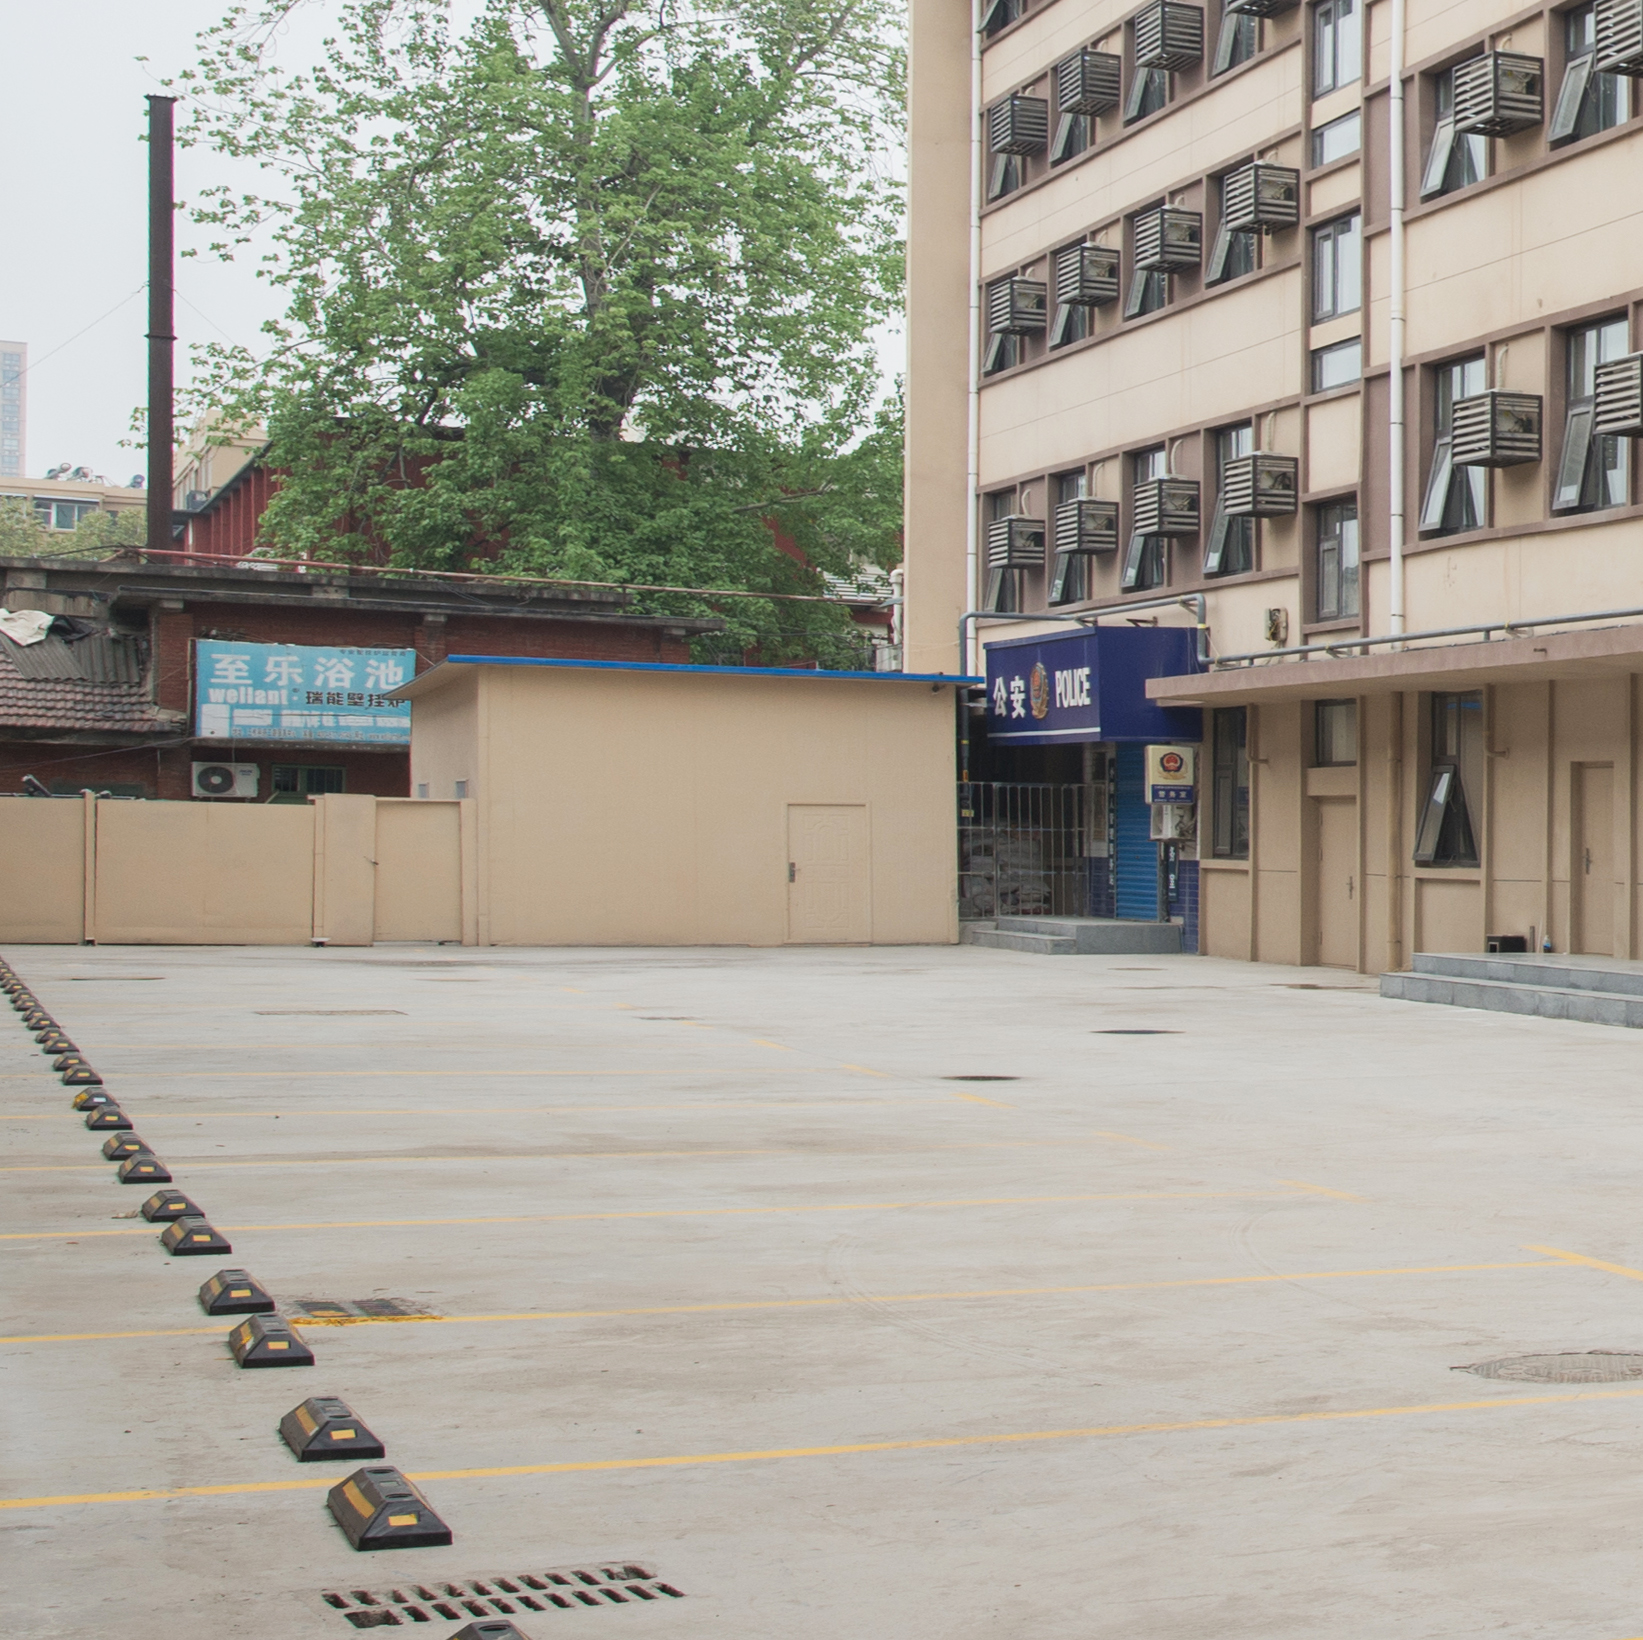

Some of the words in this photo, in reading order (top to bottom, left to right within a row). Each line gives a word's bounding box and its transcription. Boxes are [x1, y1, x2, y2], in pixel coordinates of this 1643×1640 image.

[209, 653, 404, 690] 至乐浴池
[1054, 667, 1092, 708] POLICE
[993, 675, 1026, 719] 公安
